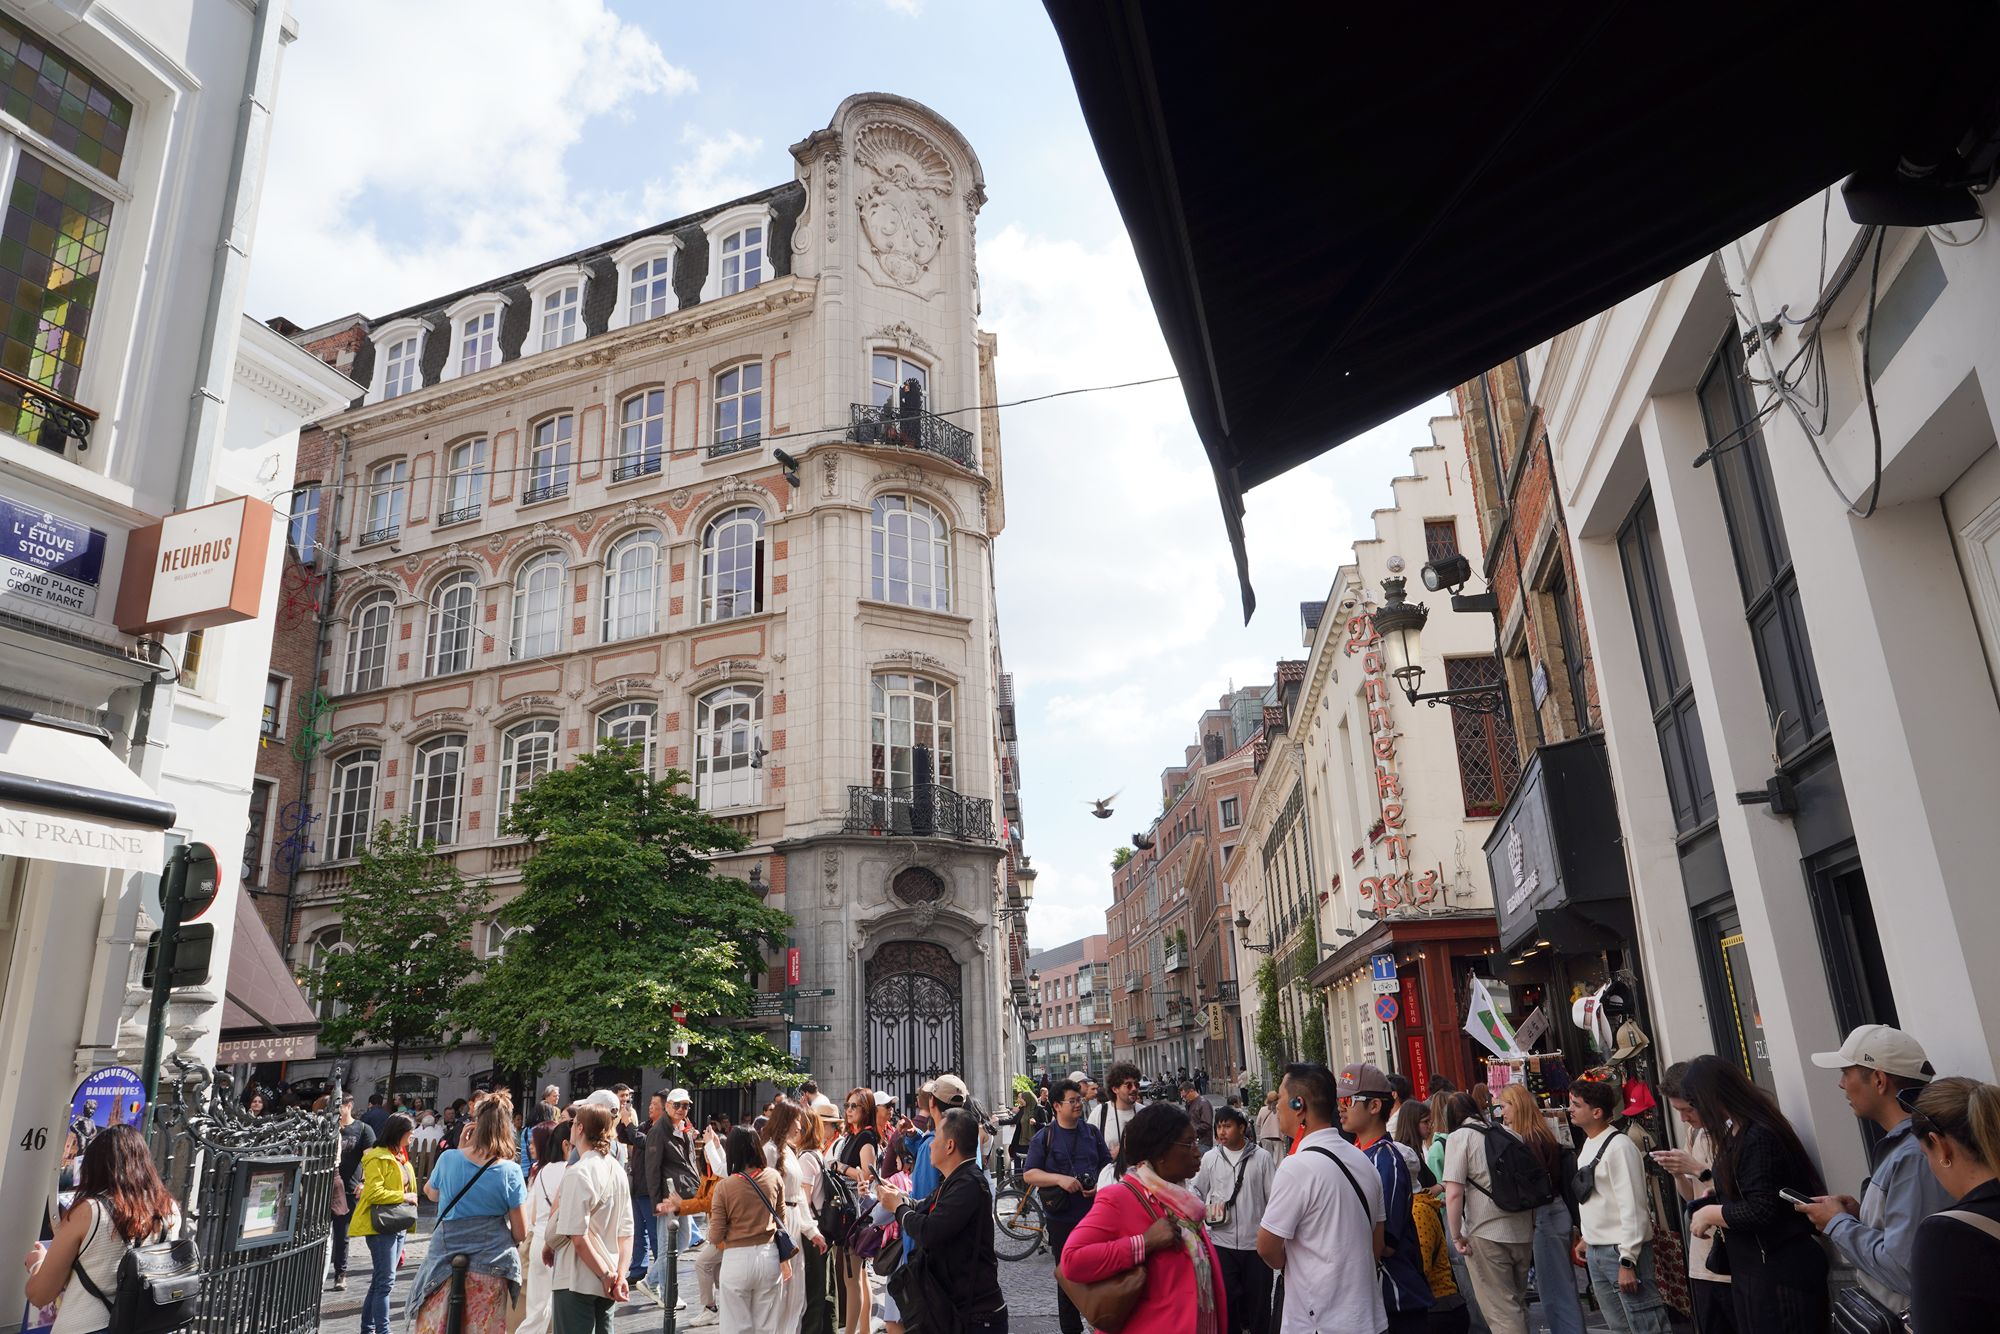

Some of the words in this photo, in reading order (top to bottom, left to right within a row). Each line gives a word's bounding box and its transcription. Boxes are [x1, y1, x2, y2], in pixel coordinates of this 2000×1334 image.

[28, 525, 75, 553] ÉTUVE
[37, 522, 48, 530] RUE
[19, 540, 65, 563] STOOF
[30, 556, 50, 567] STRAAT
[161, 537, 232, 573] NEUHAUS
[7, 579, 43, 597] GROTE
[46, 591, 83, 609] MARKT
[10, 567, 49, 586] GRAND
[52, 580, 85, 598] PLACE
[35, 822, 144, 854] PRALINE
[1407, 982, 1417, 1023] BISTRO
[93, 1068, 136, 1083] SOUVENIR
[85, 1086, 140, 1096] BANKNOTES
[20, 1127, 48, 1151] 46
